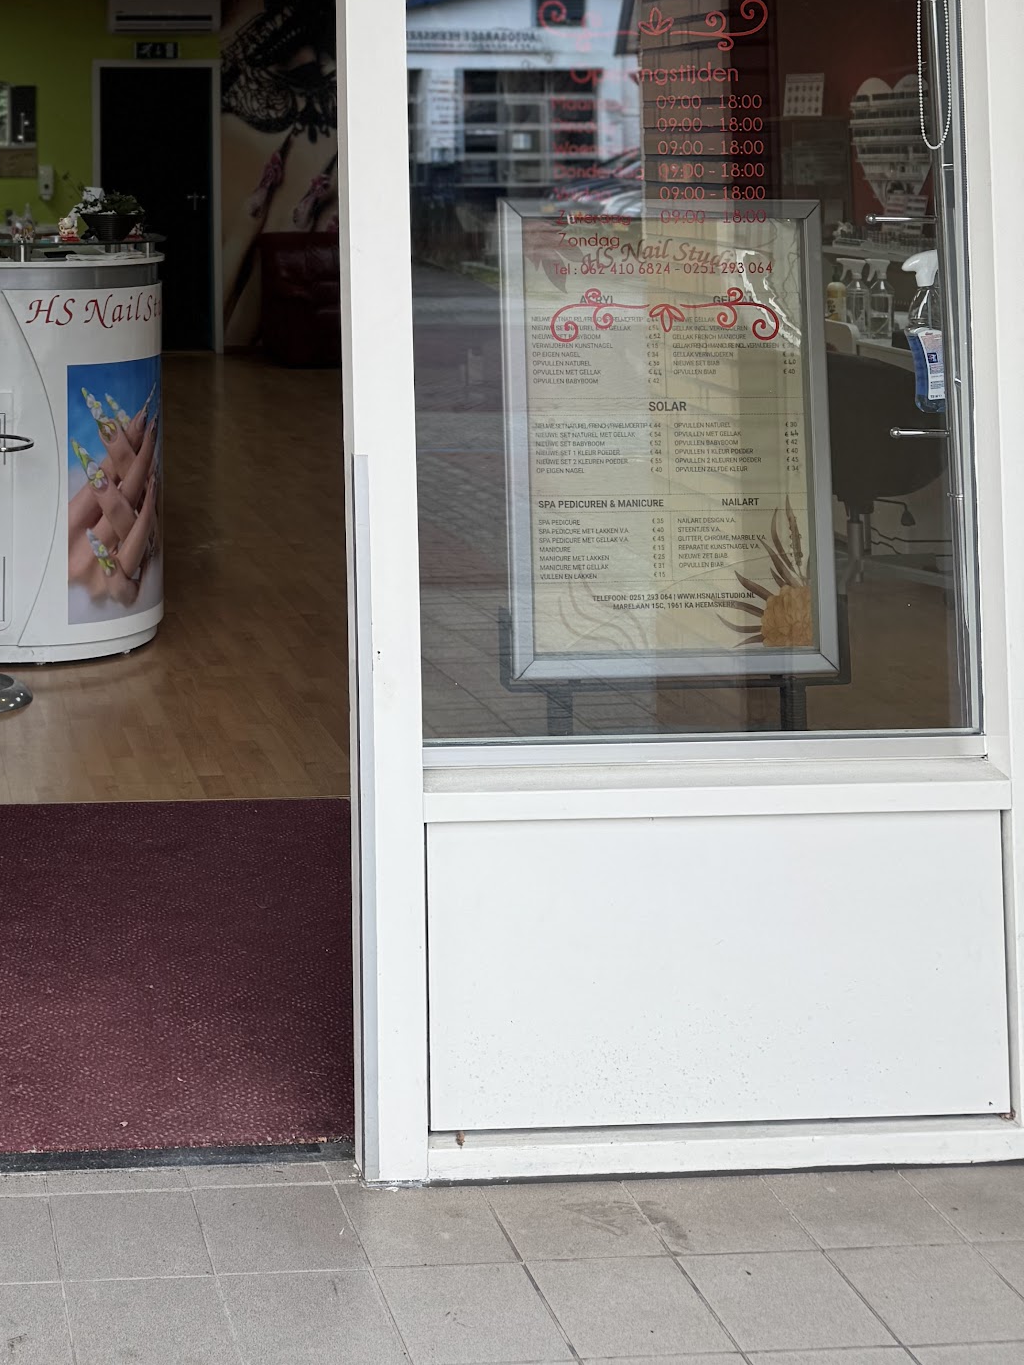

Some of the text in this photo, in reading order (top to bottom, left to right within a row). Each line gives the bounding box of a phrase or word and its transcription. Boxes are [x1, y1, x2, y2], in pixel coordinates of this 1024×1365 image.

[569, 62, 740, 86] Opngstijden
[656, 95, 702, 109] 09:00
[718, 94, 763, 109] 18:00
[656, 117, 763, 132] 09:00 18:00
[657, 140, 764, 155] 09:00 18:00
[658, 163, 704, 178] 09:00
[721, 162, 765, 178] 18:00
[659, 186, 705, 201] 09:00
[722, 186, 766, 201] 18:00
[660, 210, 706, 224] 09:00
[723, 209, 767, 224] 18:00
[557, 232, 620, 249] Zondag
[620, 238, 673, 264] Nail
[580, 262, 606, 275] 062
[610, 262, 635, 275] 410
[638, 262, 671, 275] 6824
[683, 262, 716, 274] 0251
[720, 262, 745, 274] 293
[748, 261, 773, 274] 064
[25, 294, 76, 326] HS
[83, 292, 144, 329] Nail
[648, 401, 687, 412] SOLAR
[538, 499, 664, 509] SPA PEDICUREN & MANICURE
[721, 497, 760, 506] NAILART
[677, 592, 755, 600] WWW.HSNAILSTUDIO.NL
[695, 601, 736, 609] HEEMSKERK
